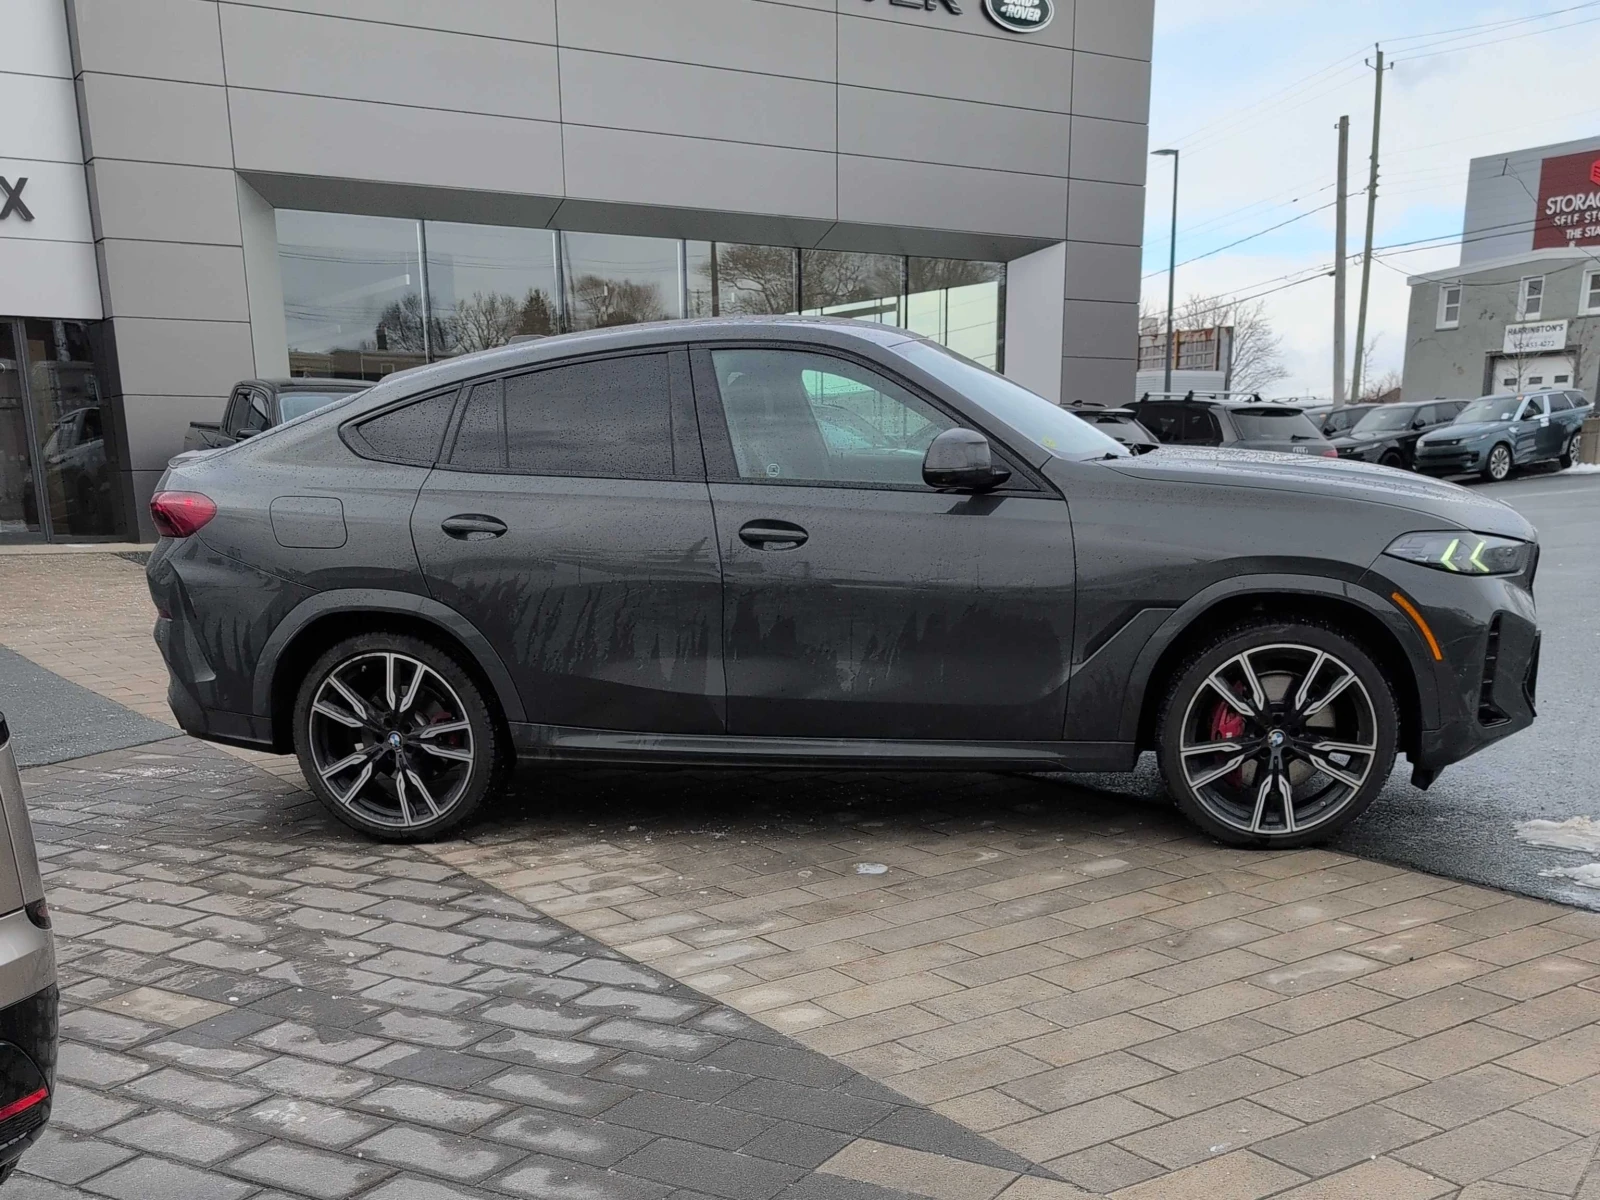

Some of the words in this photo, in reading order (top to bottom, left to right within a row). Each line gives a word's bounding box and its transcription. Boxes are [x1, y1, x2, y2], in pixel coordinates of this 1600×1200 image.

[1005, 4, 1041, 22] ROVER
[1553, 214, 1579, 226] SELF
[1566, 228, 1582, 239] THE
